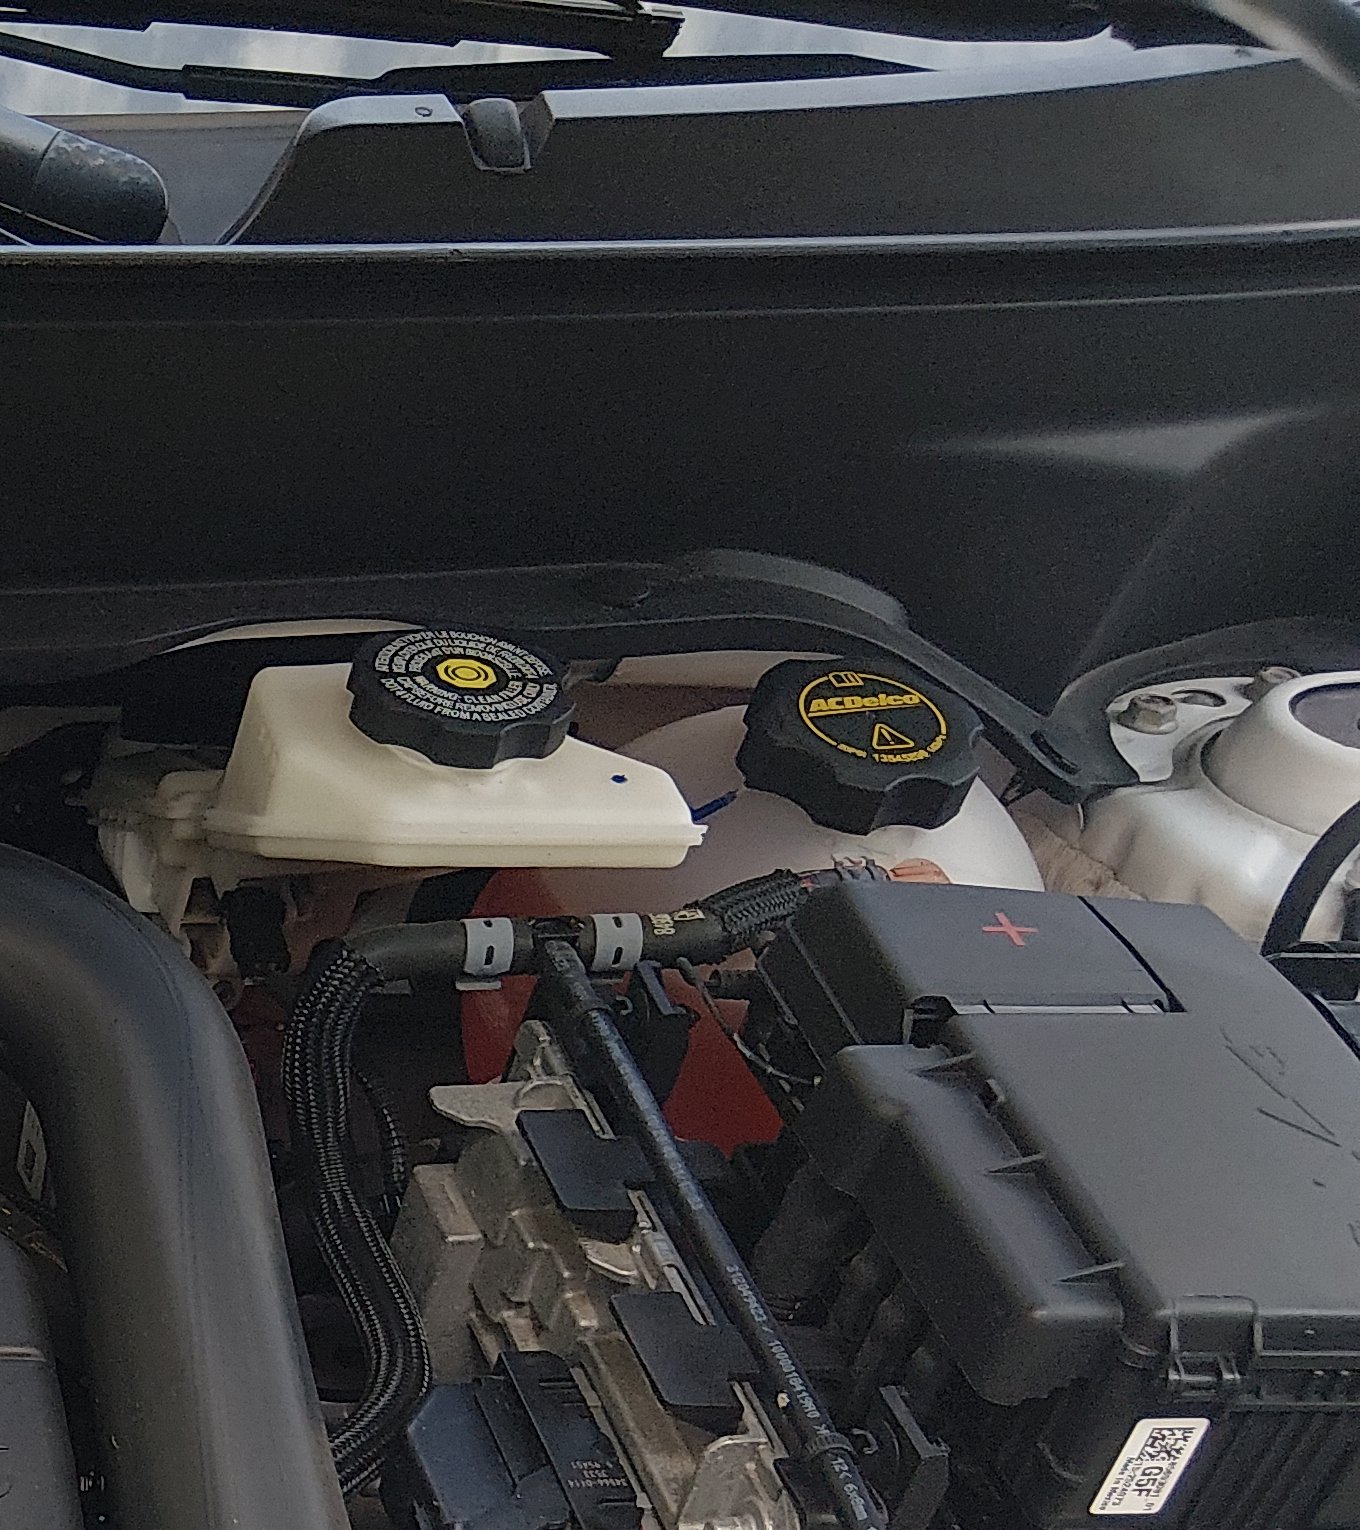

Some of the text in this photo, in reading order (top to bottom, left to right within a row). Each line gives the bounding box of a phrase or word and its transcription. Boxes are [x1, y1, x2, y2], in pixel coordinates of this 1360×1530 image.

[808, 693, 921, 712] ACDelco
[434, 706, 471, 721] FROM
[481, 708, 527, 722] SEALED
[1128, 1465, 1165, 1497] G5F
